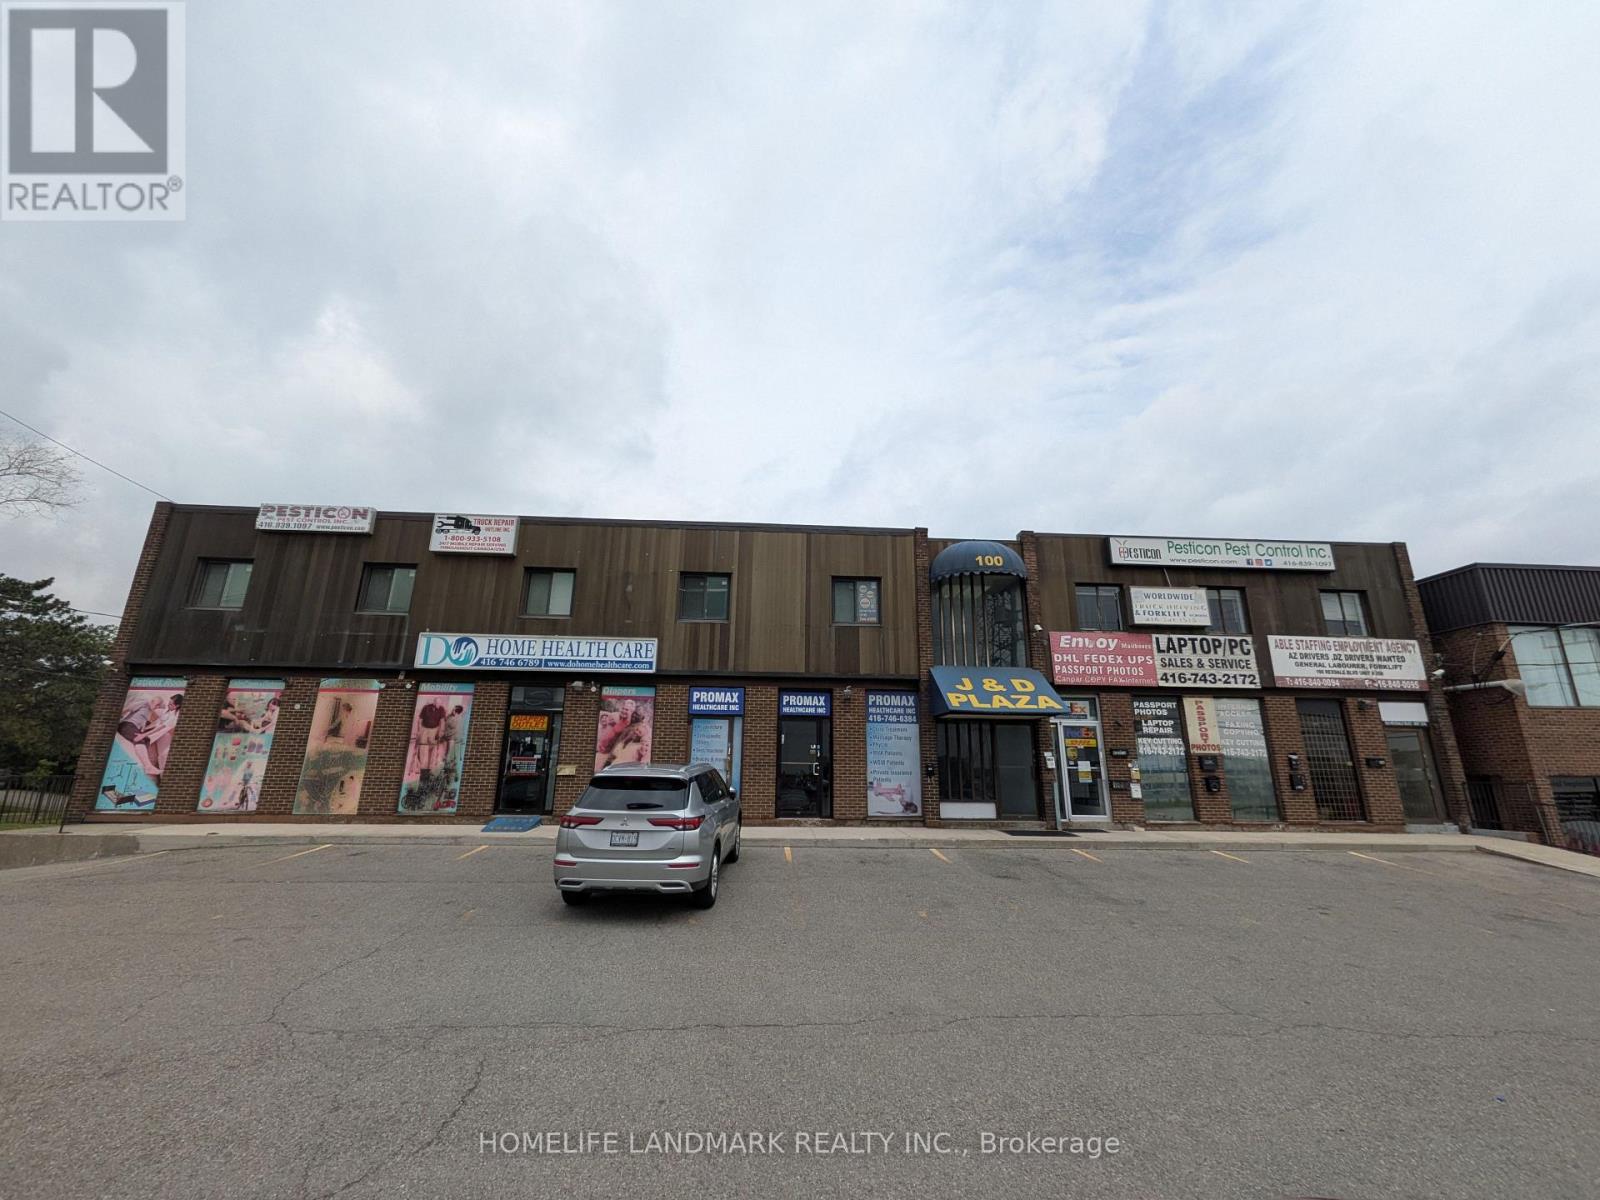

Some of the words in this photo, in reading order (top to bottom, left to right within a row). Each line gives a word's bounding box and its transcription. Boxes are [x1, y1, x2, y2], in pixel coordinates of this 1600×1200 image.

[260, 505, 369, 520] PESTICON
[1167, 541, 1222, 556] Pesticon
[1225, 542, 1250, 556] Pest
[1255, 544, 1303, 558] Control
[1306, 545, 1331, 558] Inc.
[976, 555, 1004, 566] 100
[1144, 592, 1194, 600] WORLDWIDE
[486, 638, 536, 657] HOME
[541, 640, 608, 658] HEALTH
[613, 642, 654, 659] CARE
[1155, 636, 1251, 656] LAPTOP/PC
[1274, 639, 1294, 650] ABLE
[1295, 640, 1332, 650] STAFFING
[1332, 640, 1384, 653] EMPLOYMENT
[1386, 642, 1416, 654] AGENCY
[1054, 654, 1080, 663] DHL
[1084, 654, 1124, 664] FEDEX
[1128, 656, 1153, 664] UPS
[1300, 652, 1330, 660] DRIVERS
[1344, 654, 1374, 662] DRIVERS
[480, 658, 497, 666] 416
[499, 658, 515, 666] 746
[517, 658, 540, 668] 6789
[547, 660, 650, 669] www.dohomehealthcare.com
[1160, 658, 1194, 668] SALES
[1196, 658, 1204, 668] &
[1208, 658, 1252, 670] SERVICE
[1055, 665, 1103, 674] PASSPORT
[1106, 666, 1144, 676] PHOTOS
[1160, 672, 1257, 685] 416-743-2172
[954, 678, 974, 690] J
[982, 678, 1006, 692] &
[1010, 678, 1036, 692] D
[692, 691, 739, 703] PROMAX
[782, 695, 826, 706] PROMAX
[868, 694, 915, 706] PROMAX
[946, 692, 1063, 710] PLAZA
[1190, 744, 1221, 752] PHOTOS
